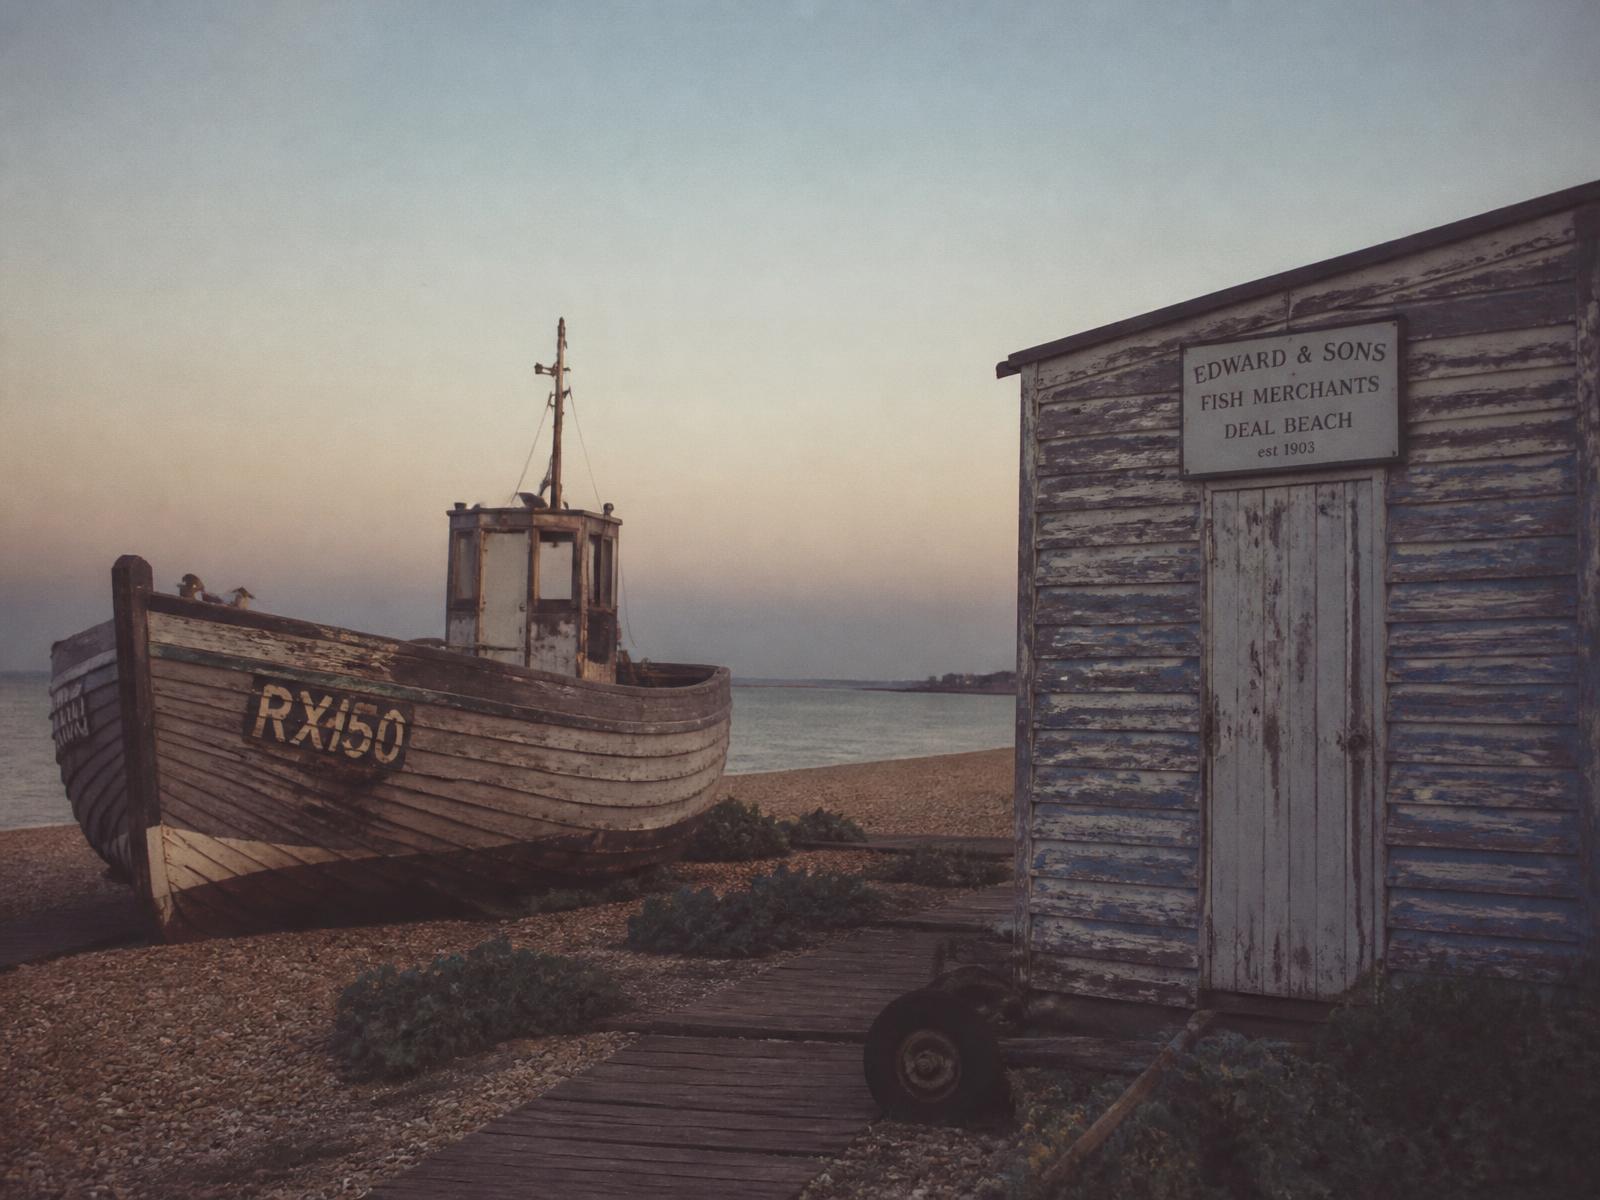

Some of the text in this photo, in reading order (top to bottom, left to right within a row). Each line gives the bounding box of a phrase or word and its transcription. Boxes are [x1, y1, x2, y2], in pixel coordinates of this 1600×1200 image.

[1193, 341, 1386, 384] EDWARD & SONS
[1201, 375, 1380, 411] FISH MERCHANTS
[1225, 412, 1353, 439] DEAL BEACH
[1258, 441, 1315, 458] est 1903
[252, 684, 406, 764] RX150
